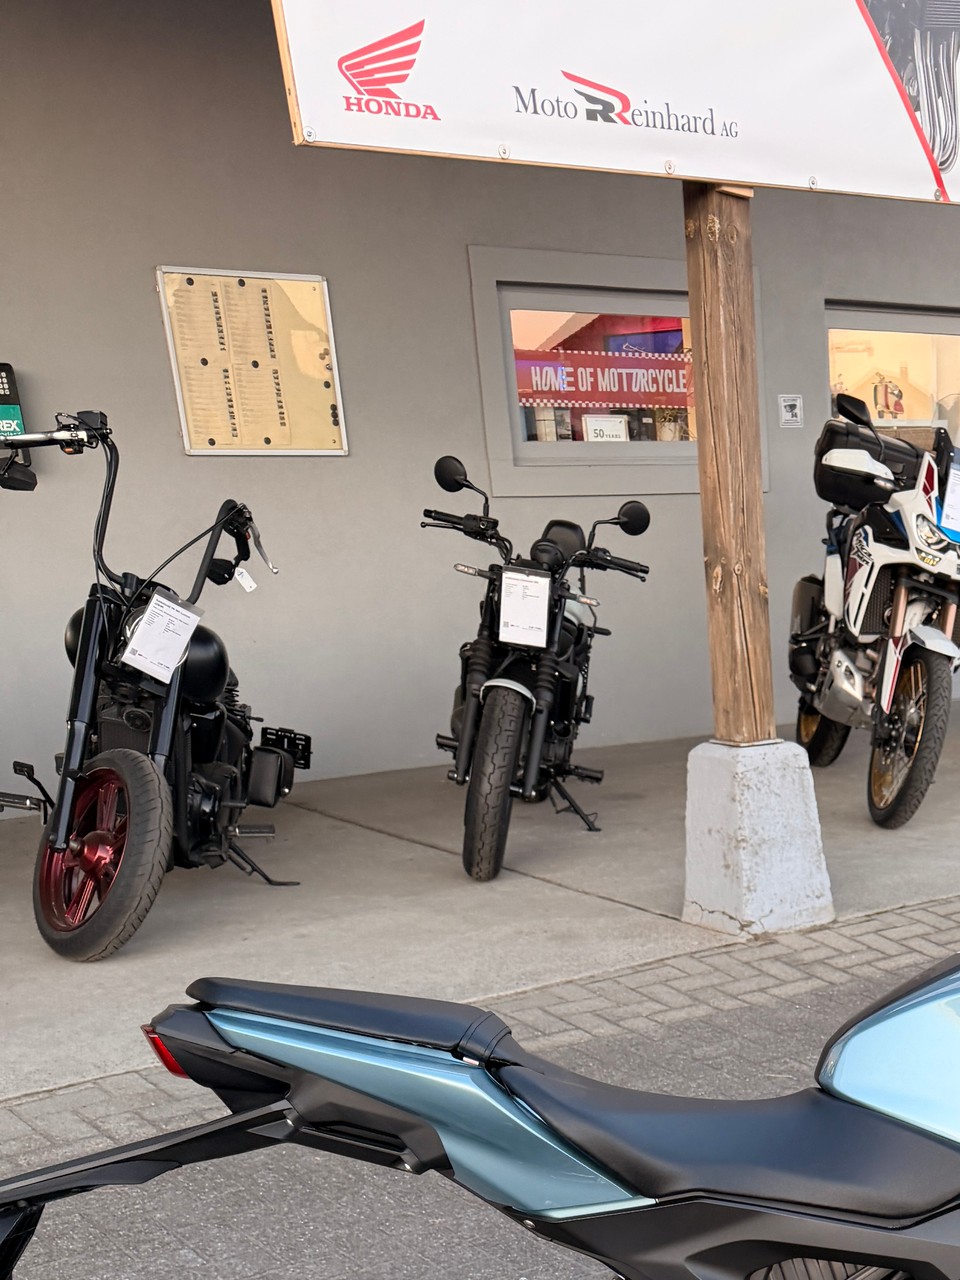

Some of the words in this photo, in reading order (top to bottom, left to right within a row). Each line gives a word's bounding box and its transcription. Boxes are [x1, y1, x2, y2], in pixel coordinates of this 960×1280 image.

[342, 95, 442, 121] HONDA
[512, 85, 578, 120] Moto
[720, 121, 740, 138] AG
[531, 366, 576, 392] HOME
[577, 367, 594, 392] OF
[593, 428, 605, 439] 50
